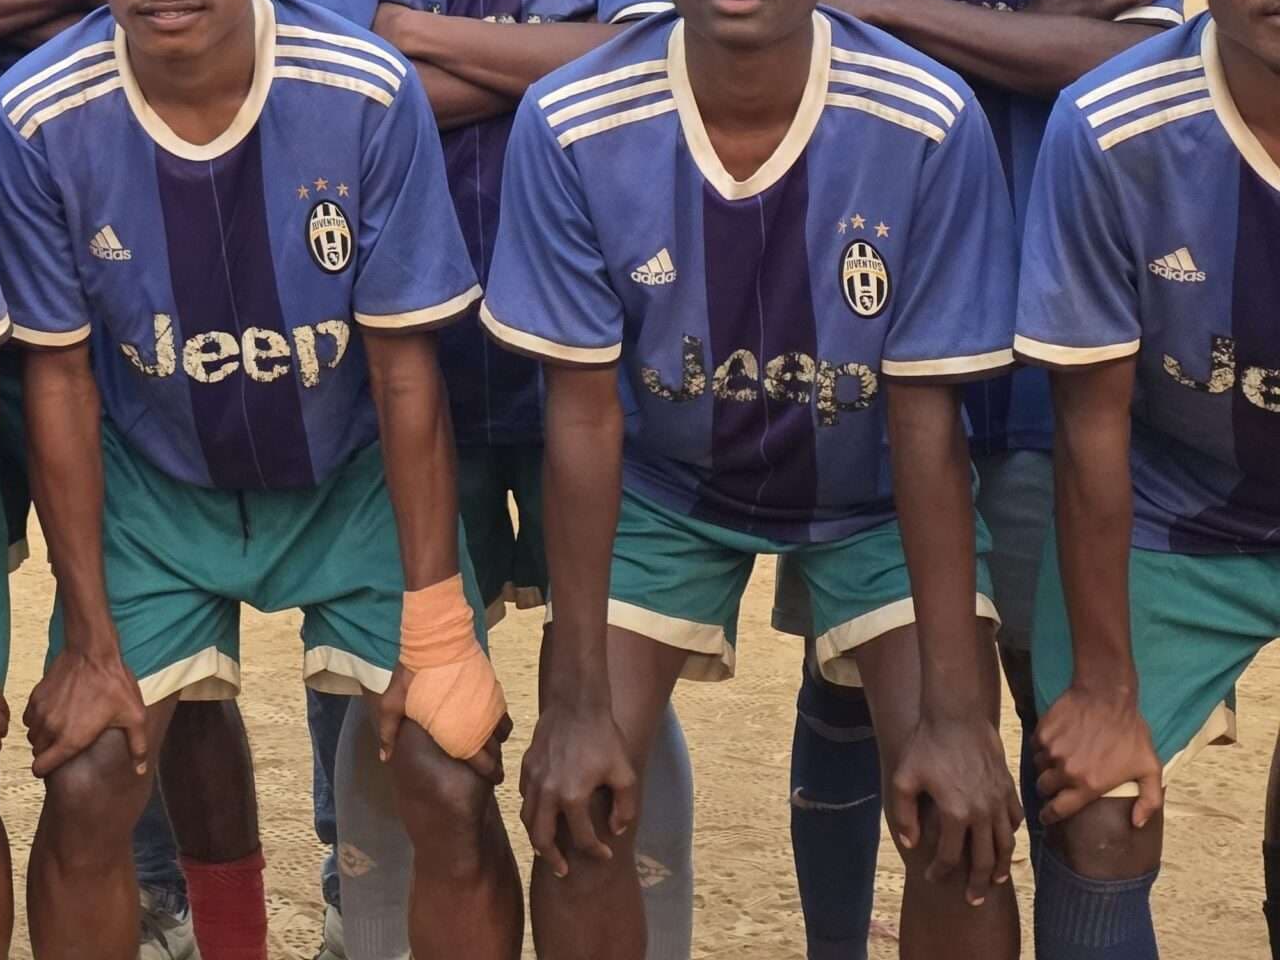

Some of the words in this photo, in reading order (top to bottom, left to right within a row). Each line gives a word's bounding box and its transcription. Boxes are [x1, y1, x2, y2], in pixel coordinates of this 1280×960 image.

[311, 217, 346, 231] JUVENTUS
[846, 259, 883, 271] JUVENTUS
[1148, 262, 1206, 282] adidas
[121, 313, 350, 389] Jeep
[641, 335, 878, 427] Jeep
